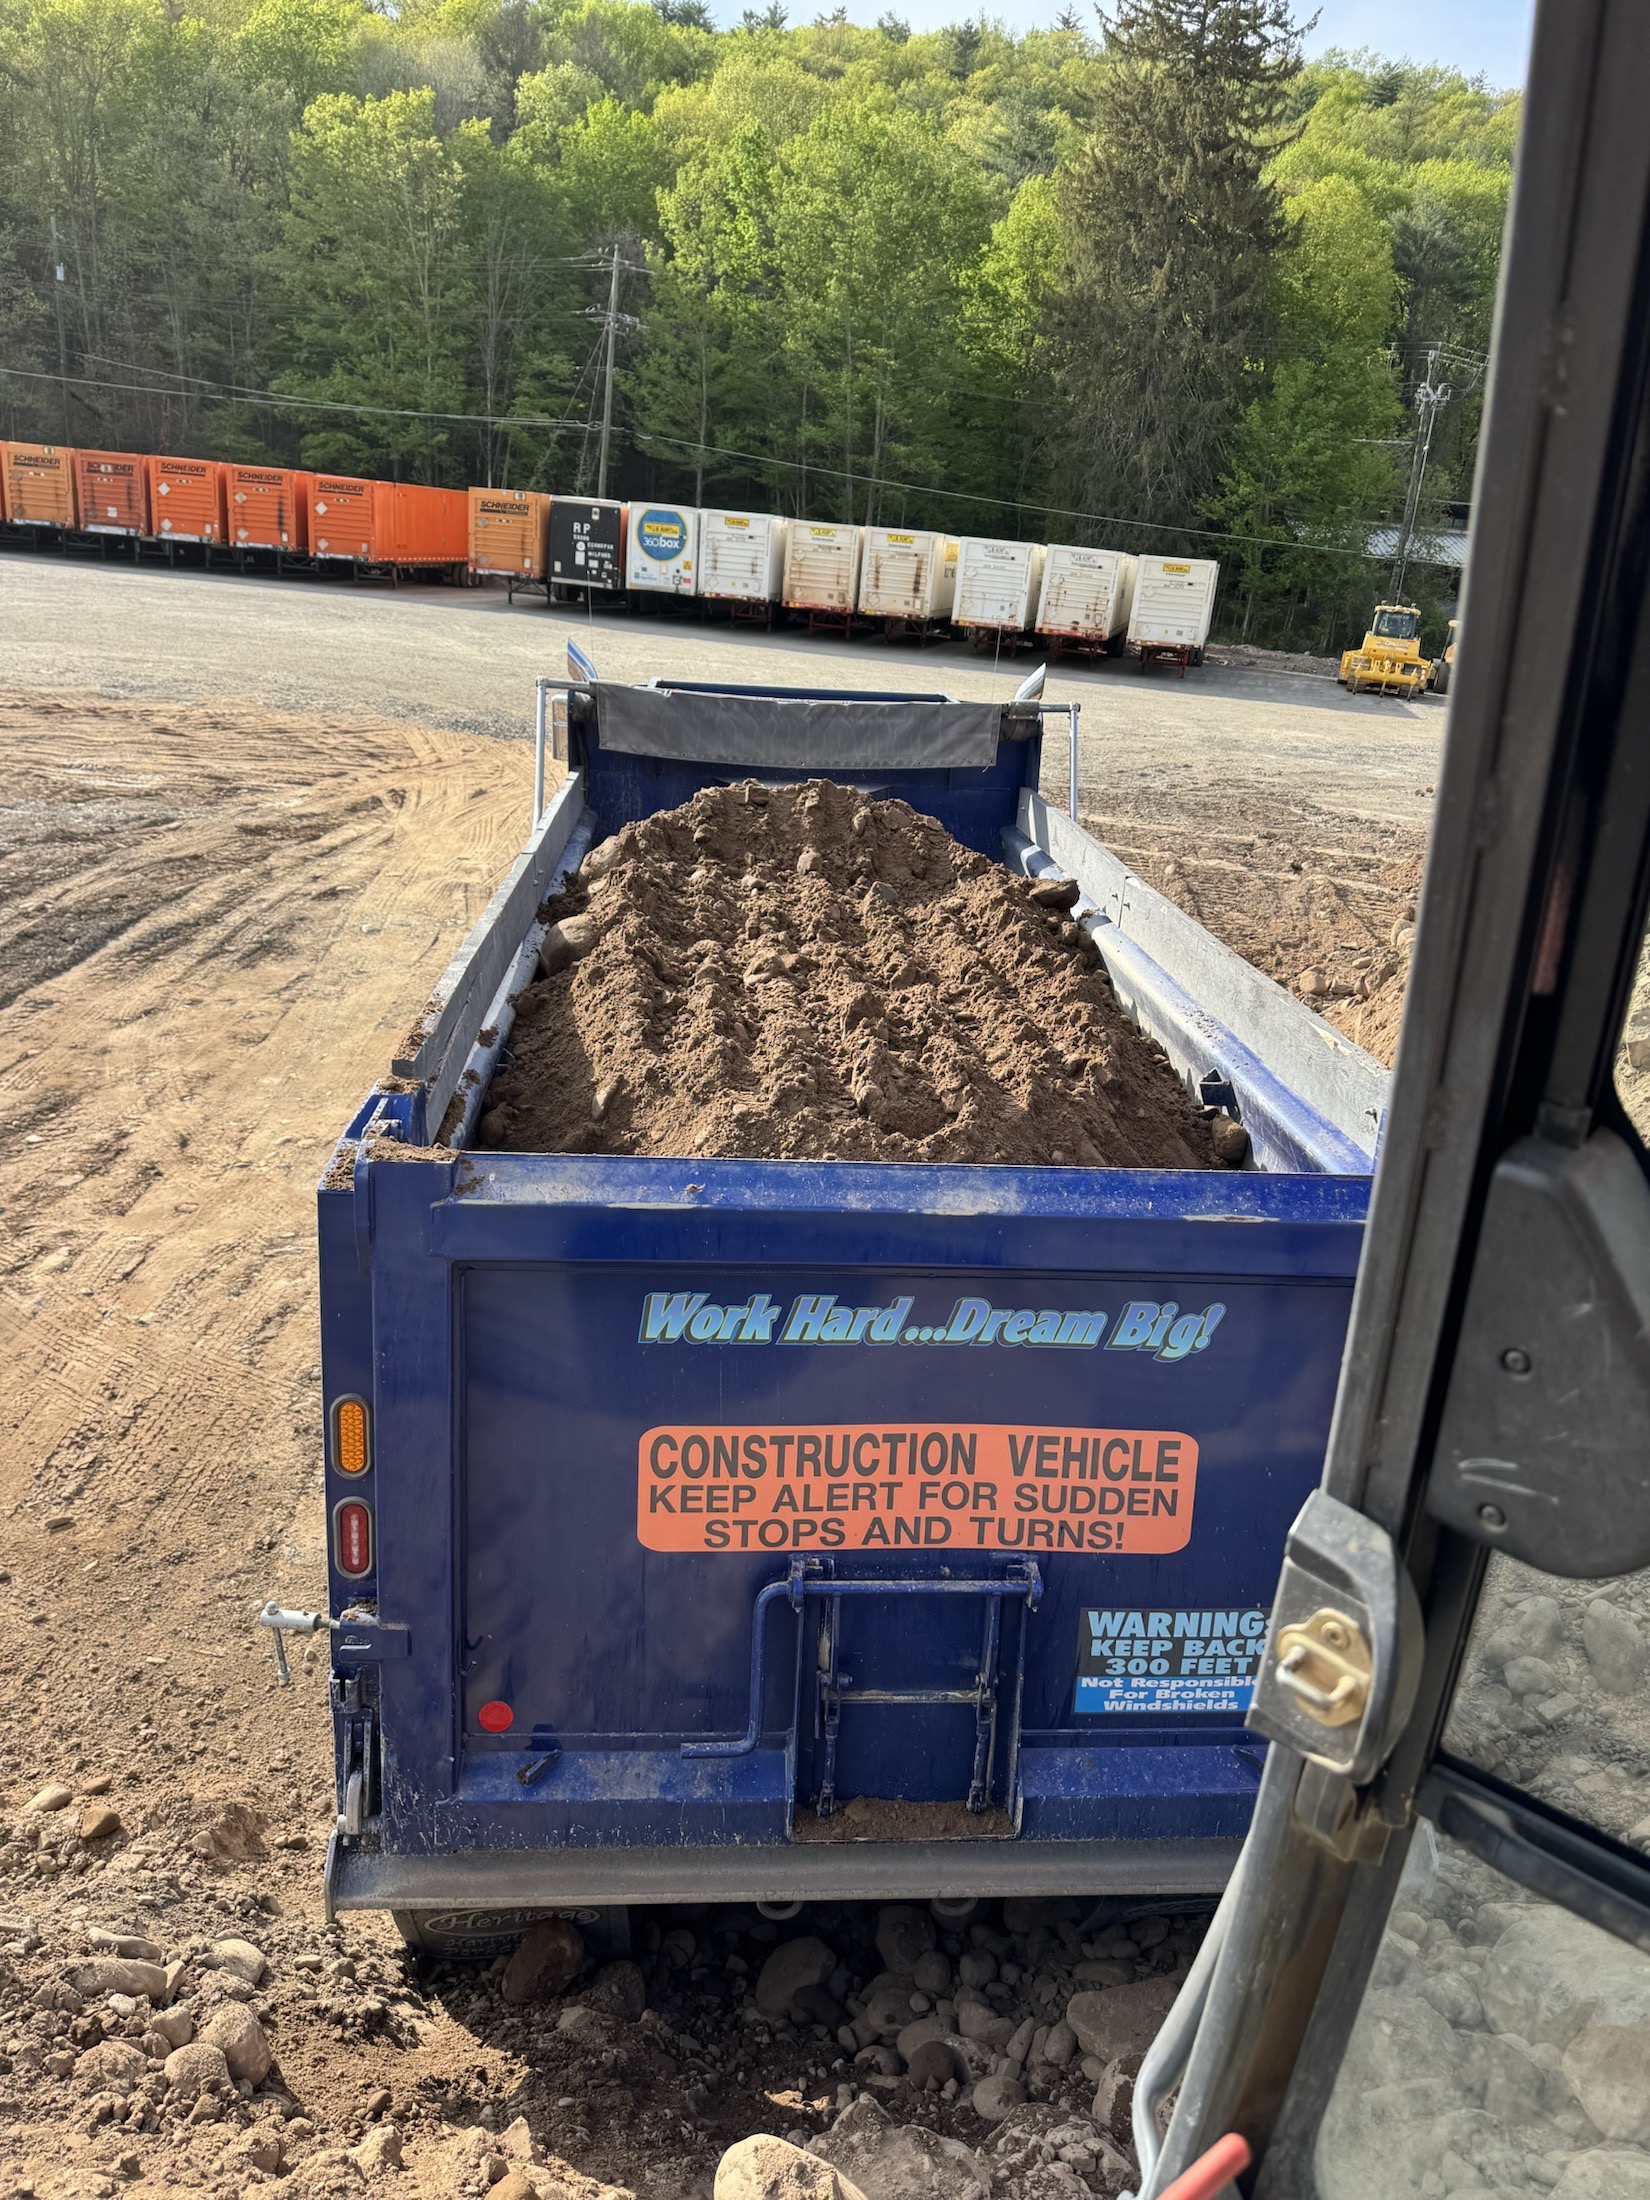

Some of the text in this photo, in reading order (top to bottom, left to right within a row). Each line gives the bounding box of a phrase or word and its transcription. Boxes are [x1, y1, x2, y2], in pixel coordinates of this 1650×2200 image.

[13, 454, 60, 465] SCHNEIDER
[86, 461, 134, 472] SCEIDER
[161, 462, 206, 473] SCHNEIDER
[237, 471, 283, 481] SCHNEIDER
[318, 481, 365, 492] SCHNEIDER
[480, 500, 530, 511] SCHNEIDER
[638, 1292, 781, 1345] Work
[1103, 1301, 1227, 1363] Big!
[649, 1433, 1182, 1483] CONSTRUCTION VEHICLE
[649, 1481, 1179, 1517] KEEP ALERT FOR SUDDEN
[703, 1516, 1125, 1550] STOPS AND TURNS!
[1090, 1638, 1266, 1657] KEEP BACK
[1105, 1657, 1253, 1675] 300 FEET
[1081, 1677, 1124, 1688] Not
[1108, 1687, 1236, 1699] For Broken
[1103, 1699, 1239, 1712] Windshields
[437, 1910, 592, 1930] Heritage
